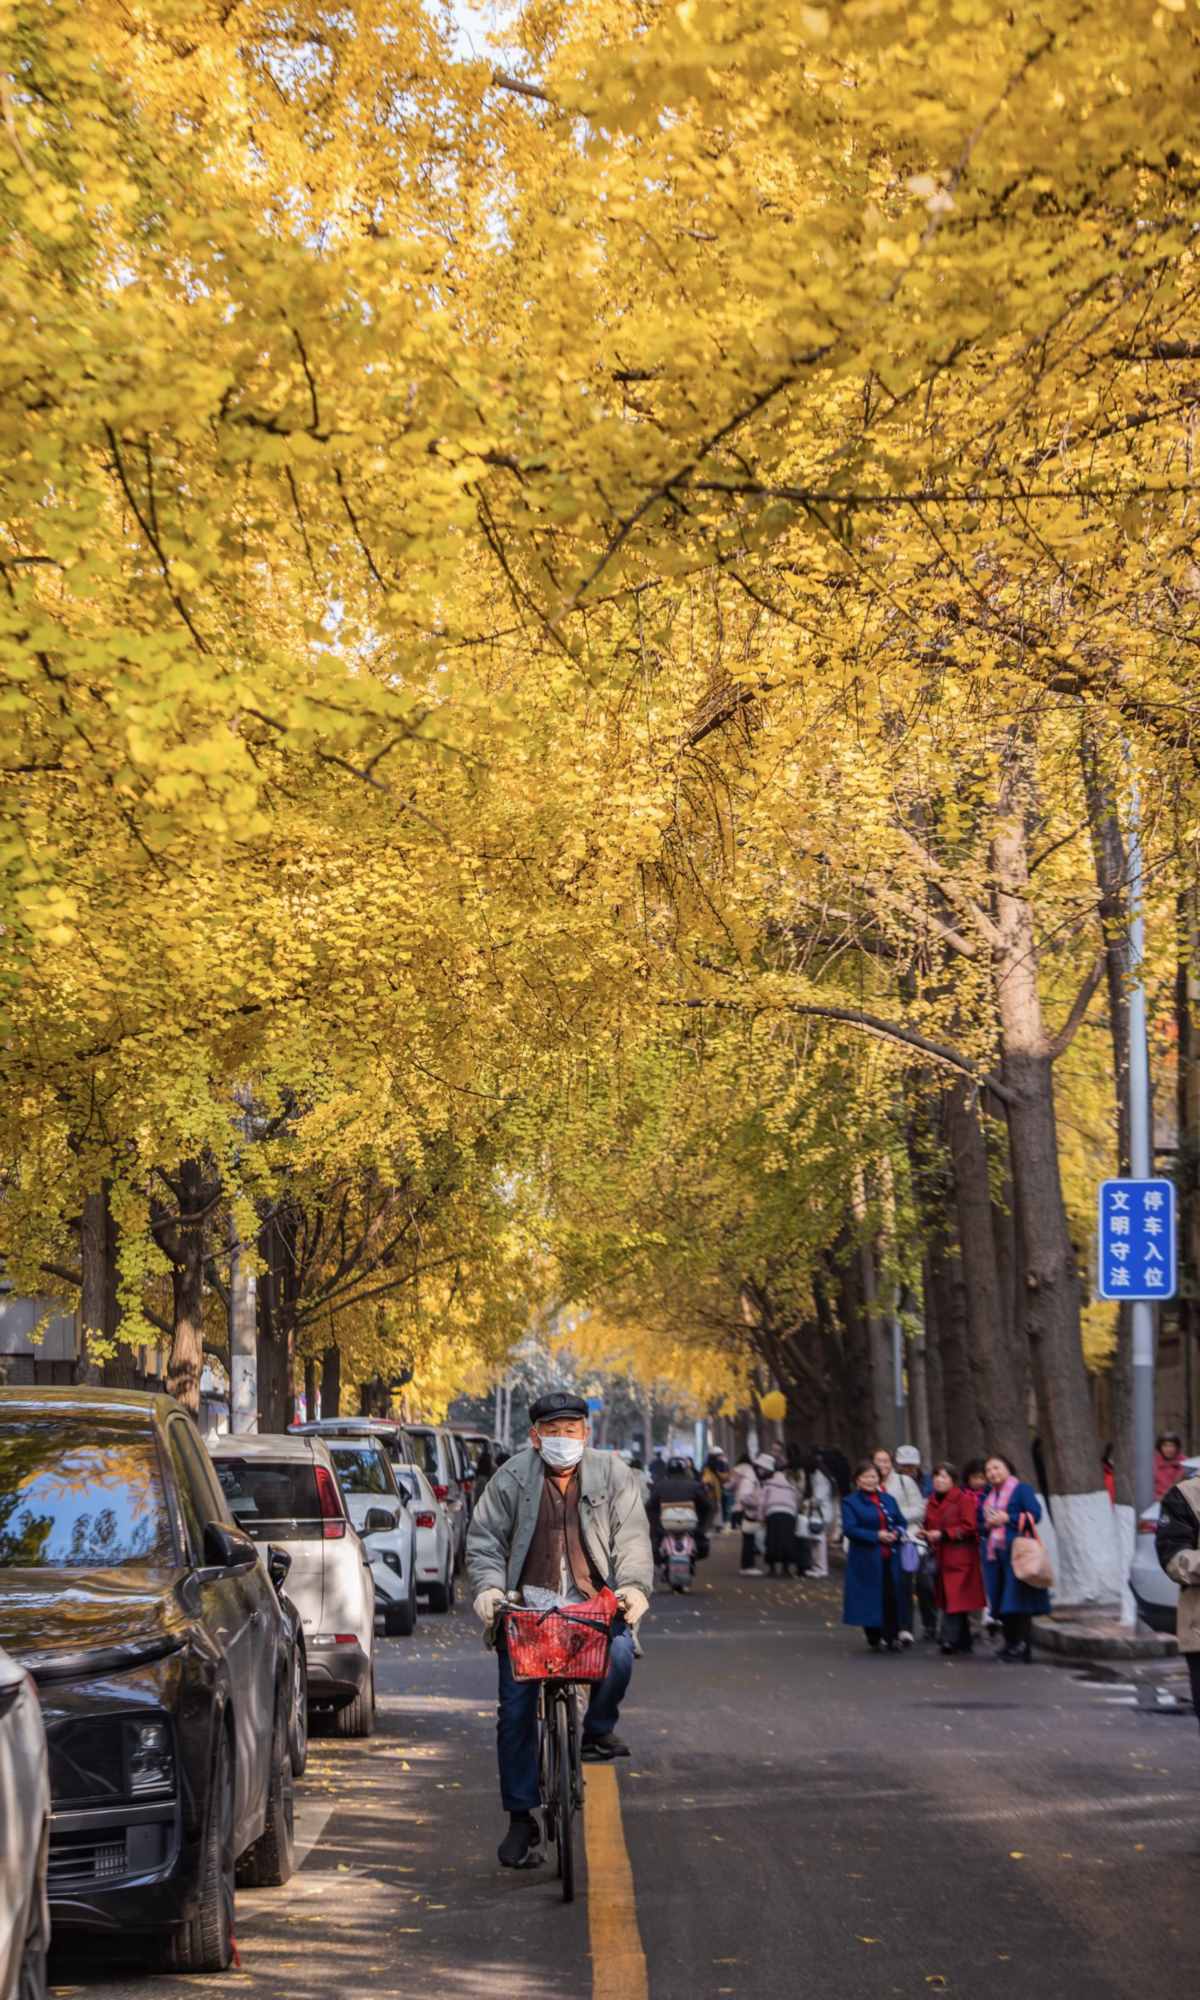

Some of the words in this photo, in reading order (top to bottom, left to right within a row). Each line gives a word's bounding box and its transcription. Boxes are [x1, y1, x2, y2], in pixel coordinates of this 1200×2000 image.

[1110, 1190, 1130, 1286] 文明守法
[1143, 1190, 1164, 1287] 停车入位
